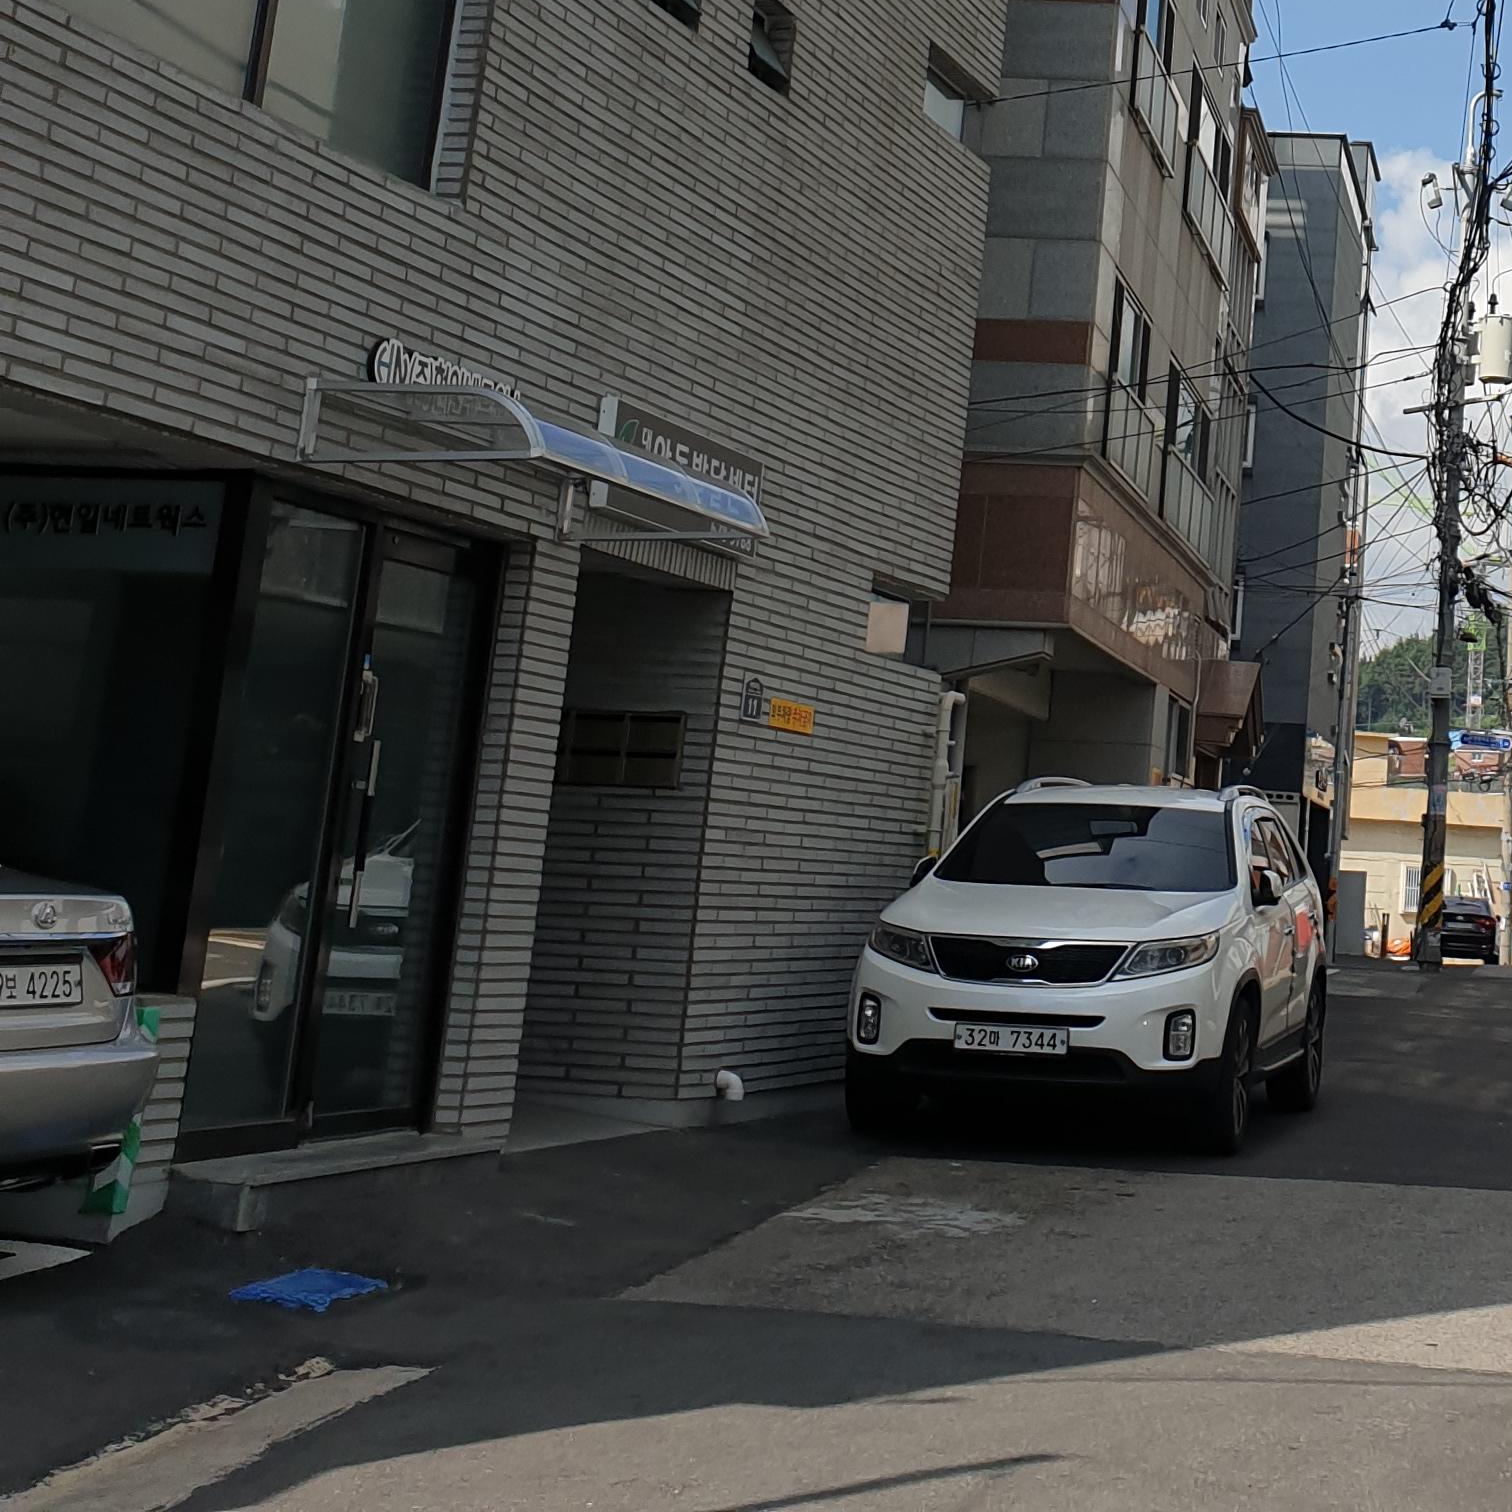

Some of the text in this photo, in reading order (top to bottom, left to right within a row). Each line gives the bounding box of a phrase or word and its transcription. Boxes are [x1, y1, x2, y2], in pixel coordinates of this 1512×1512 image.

[1010, 955, 1036, 969] KIA
[26, 970, 73, 1000] 4225
[964, 1028, 1058, 1051] 32마 7344
